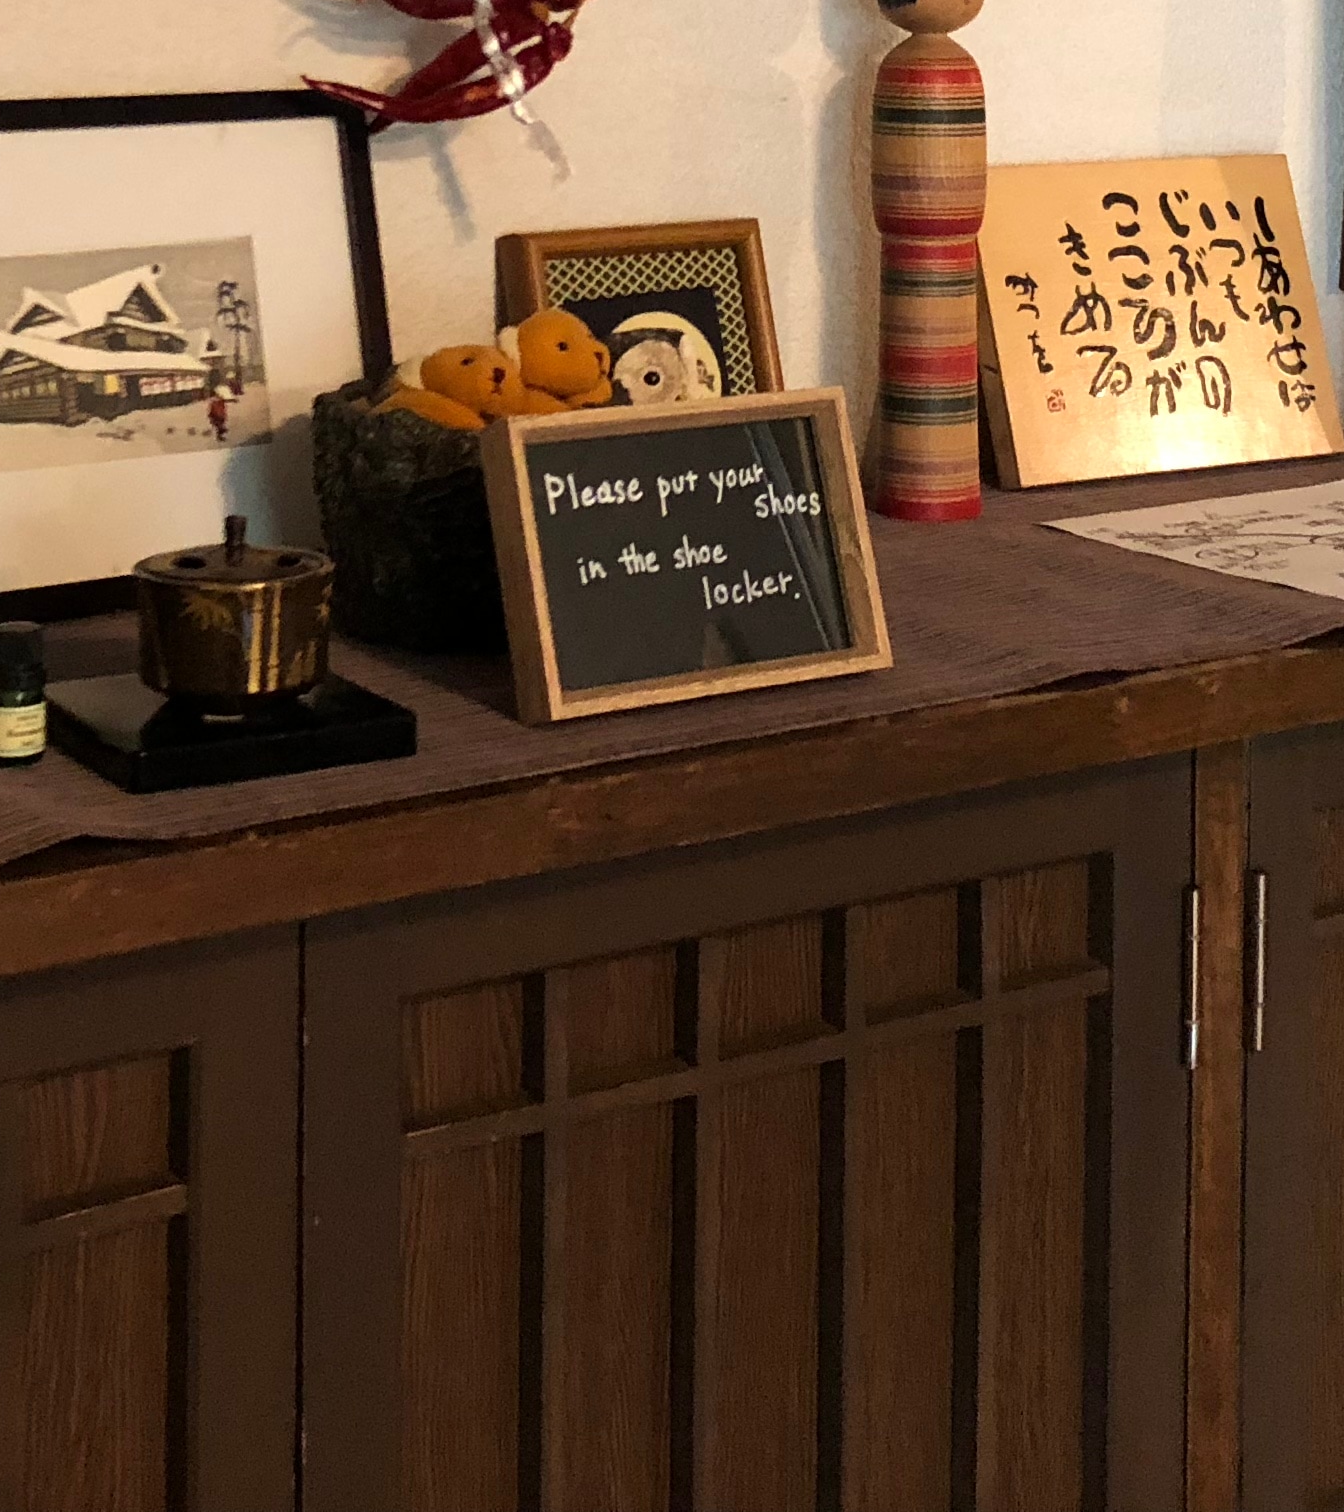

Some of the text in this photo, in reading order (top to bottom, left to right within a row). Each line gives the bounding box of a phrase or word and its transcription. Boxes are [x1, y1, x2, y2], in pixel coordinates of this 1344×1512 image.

[1158, 189, 1233, 418] じぶんの
[1198, 200, 1250, 322] いつも
[1251, 196, 1317, 413] しあわせは
[1058, 222, 1134, 398] きめる
[543, 462, 765, 517] Please put your
[754, 483, 822, 519] shoes
[576, 534, 728, 587] in the shoe
[702, 569, 802, 609] locker.
